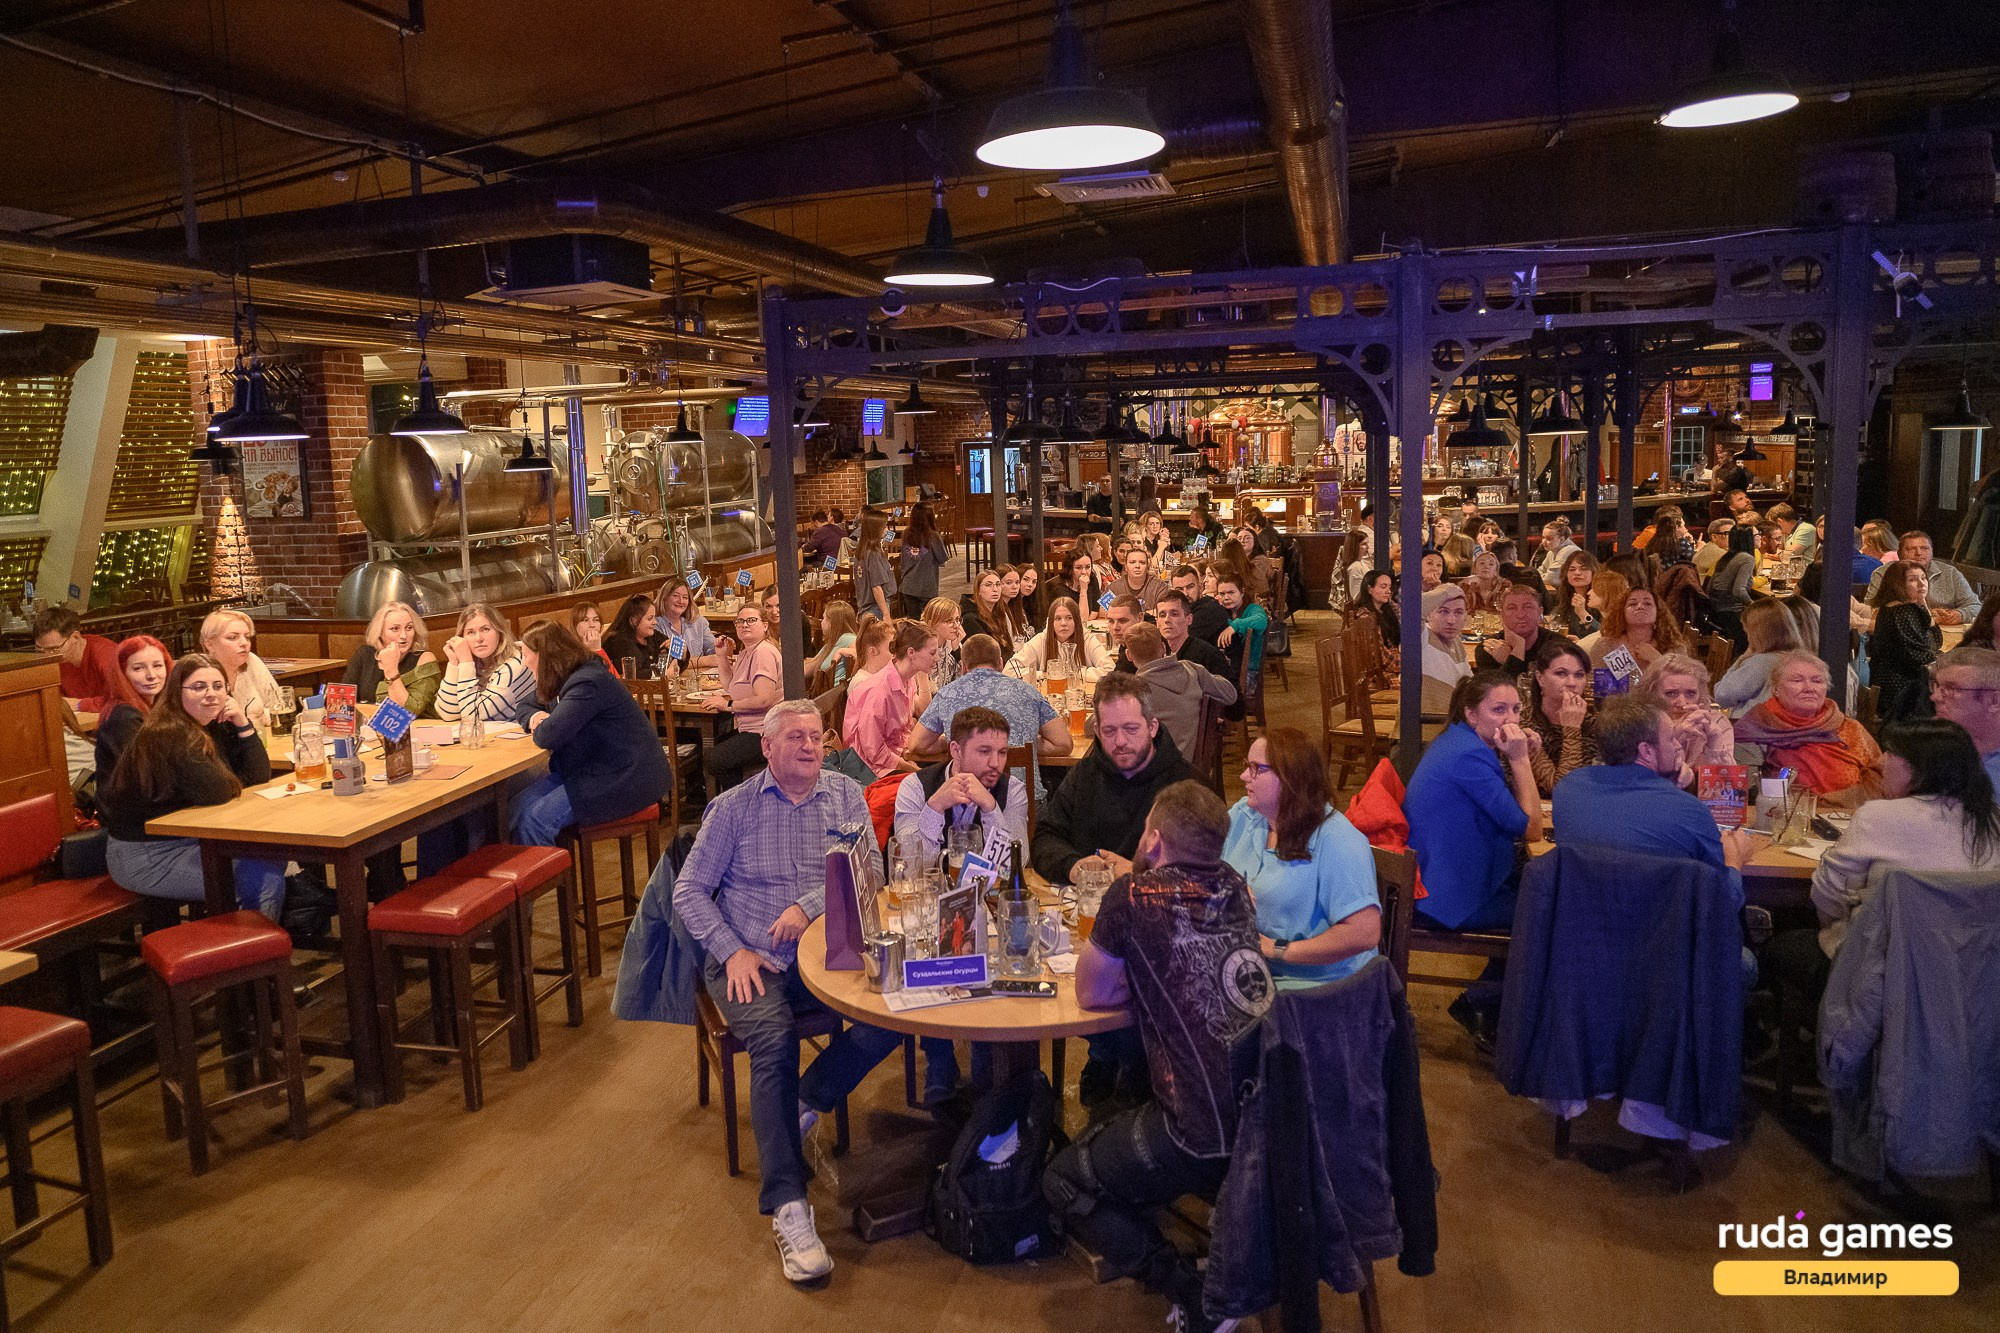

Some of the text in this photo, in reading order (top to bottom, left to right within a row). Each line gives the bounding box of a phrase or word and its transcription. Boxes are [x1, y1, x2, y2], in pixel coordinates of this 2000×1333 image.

[243, 447, 298, 462] НА ВЫНОС!
[1609, 653, 1632, 672] 404
[379, 714, 401, 733] 102
[987, 839, 1012, 868] 512
[912, 967, 979, 979] Суздальские Огурцы
